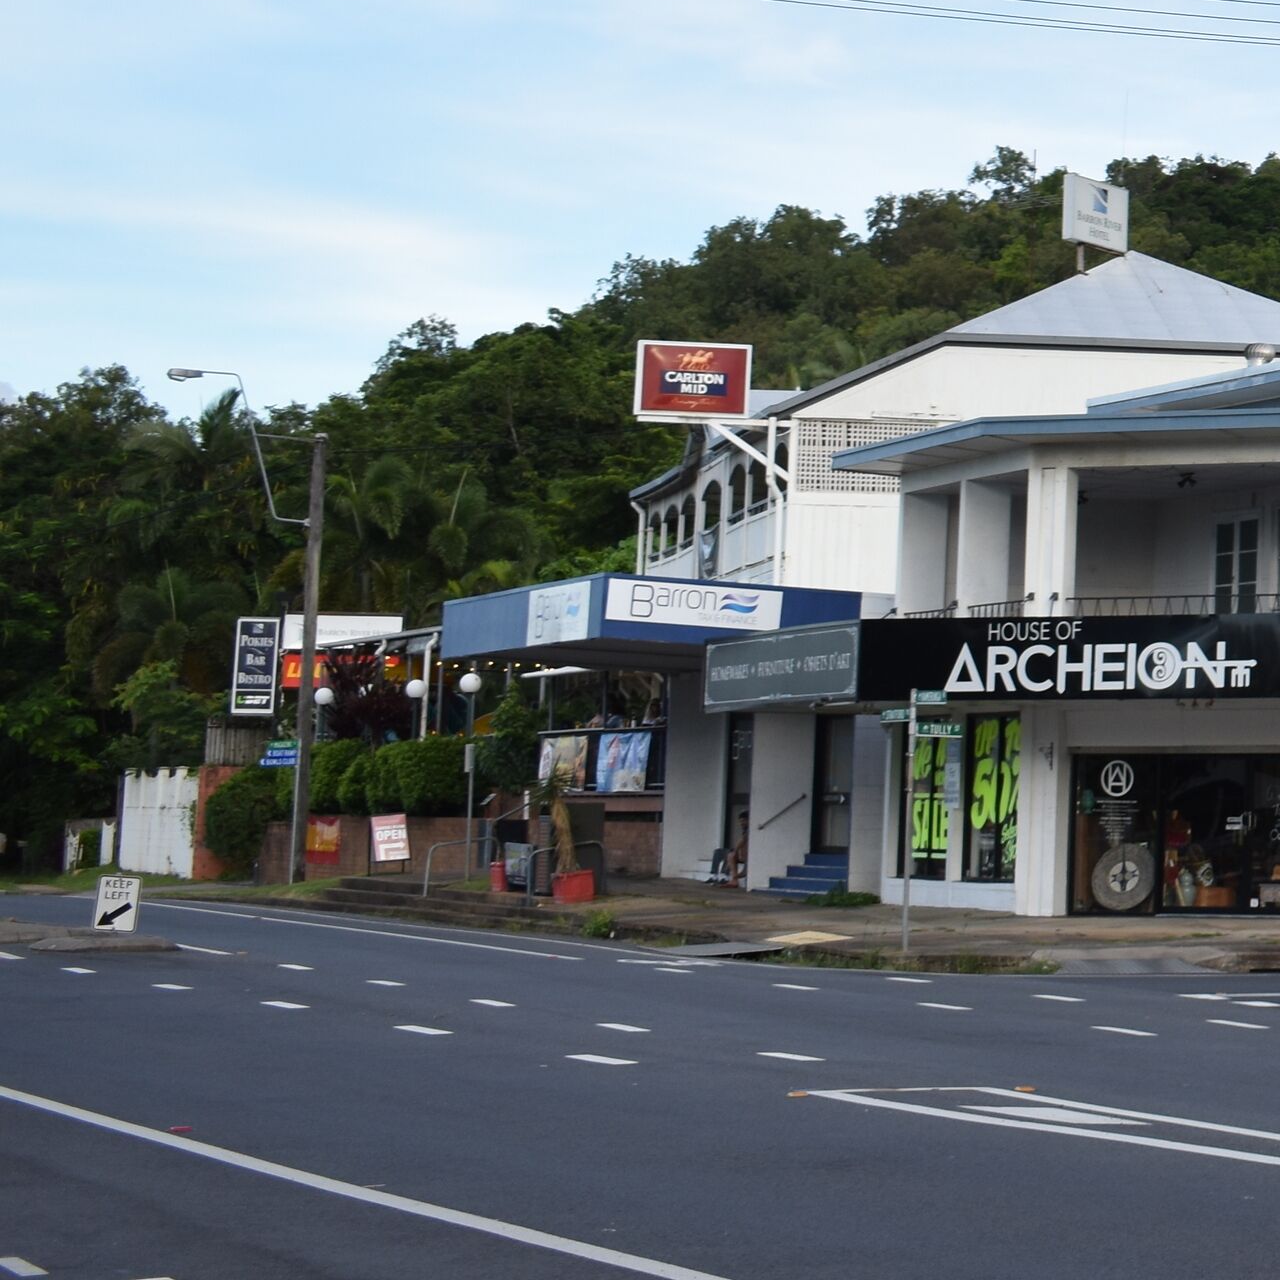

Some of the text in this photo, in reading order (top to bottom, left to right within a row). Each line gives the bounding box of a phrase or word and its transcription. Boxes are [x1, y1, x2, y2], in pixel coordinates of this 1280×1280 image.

[664, 371, 724, 385] CARLTON
[680, 384, 708, 395] MID
[630, 583, 718, 618] Barron
[988, 621, 1083, 641] HOUSE OF
[943, 640, 1228, 695] ARCHEION
[930, 723, 952, 735] TULLY
[376, 828, 407, 841] OPEN
[105, 880, 133, 889] KEEP
[104, 891, 131, 900] LEFT
